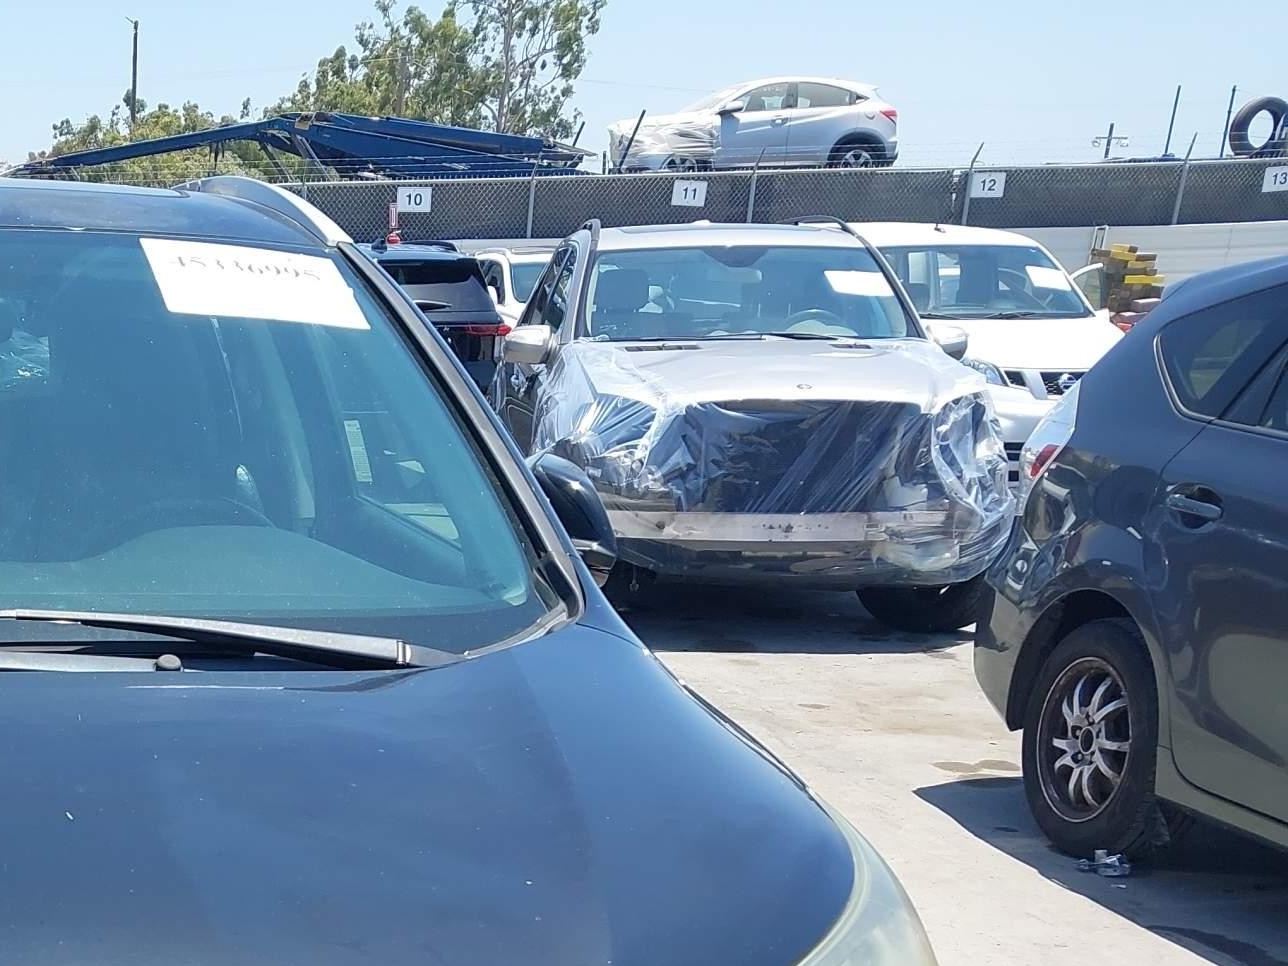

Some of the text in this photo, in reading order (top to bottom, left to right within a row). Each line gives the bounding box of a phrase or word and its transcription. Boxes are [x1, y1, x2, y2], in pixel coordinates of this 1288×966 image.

[980, 178, 997, 191] 12
[1272, 171, 1288, 186] 13
[405, 193, 423, 206] 10
[682, 186, 697, 201] 11
